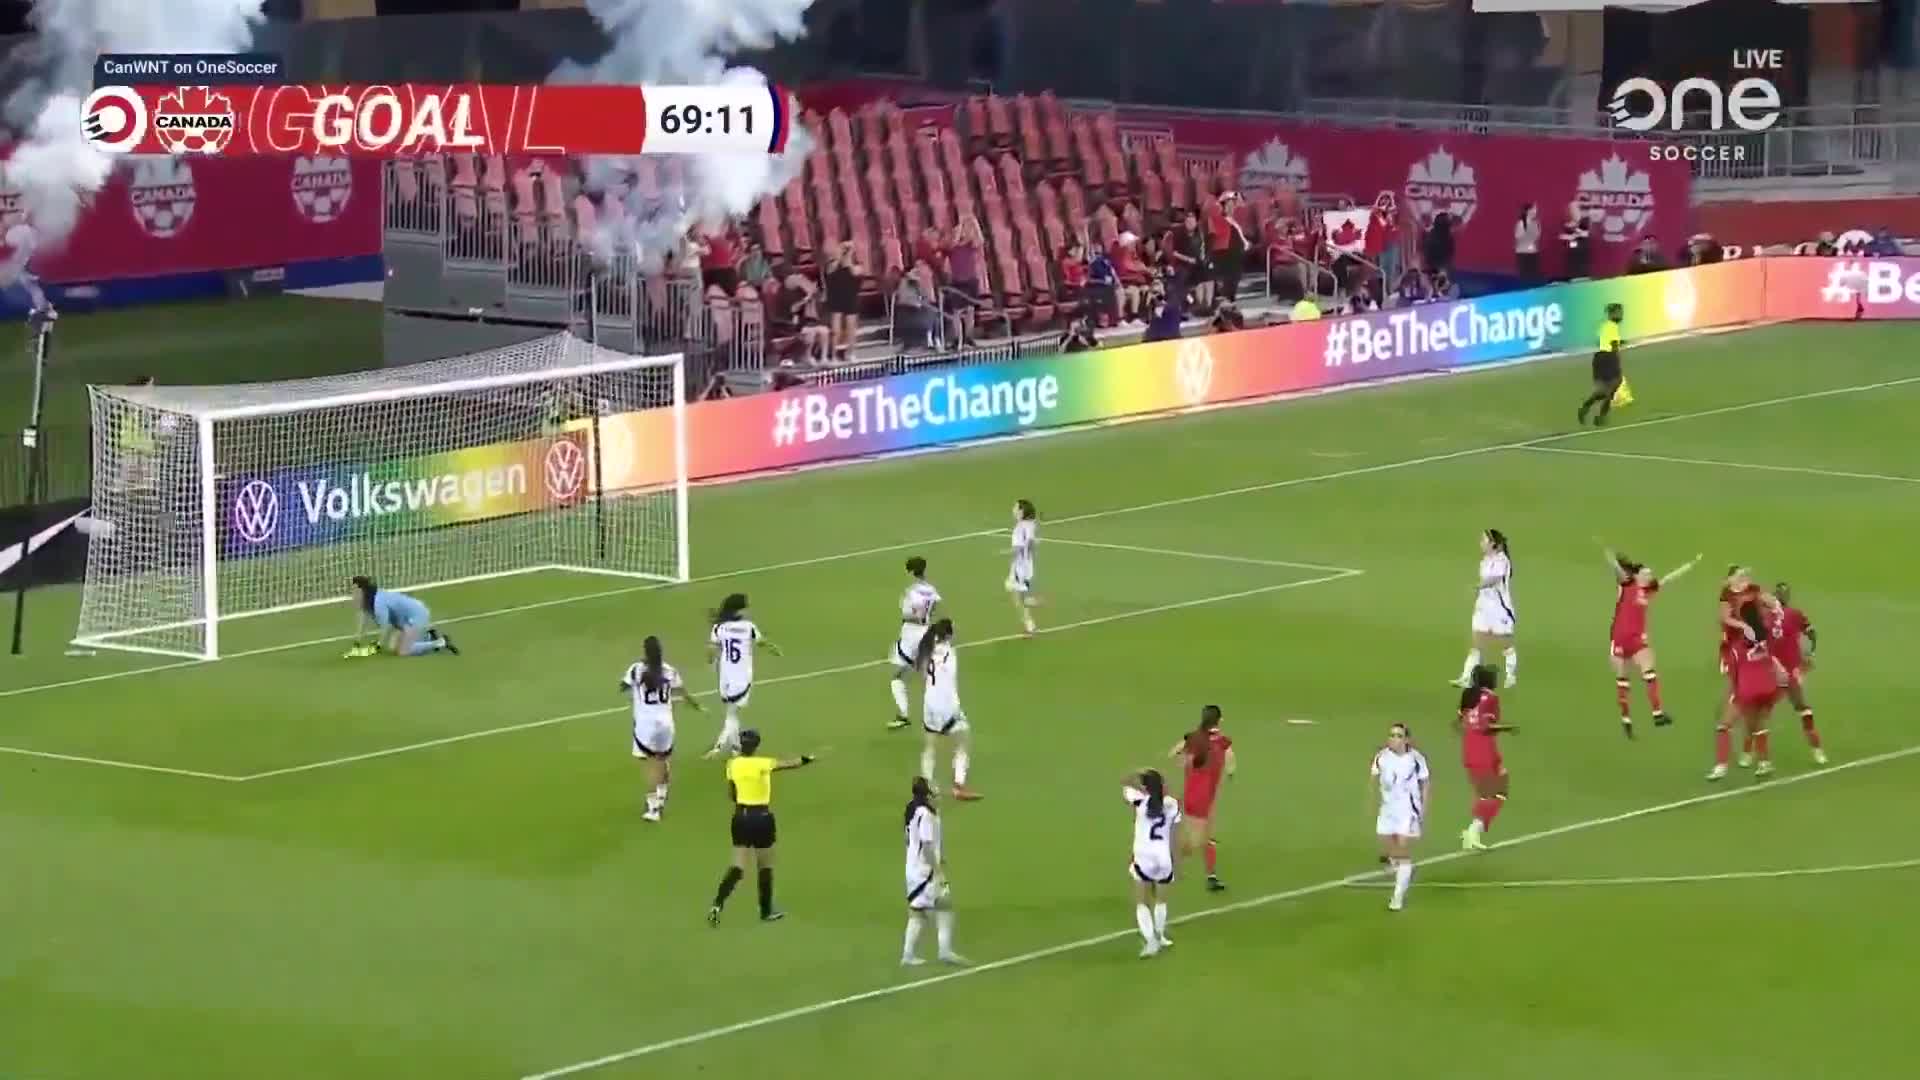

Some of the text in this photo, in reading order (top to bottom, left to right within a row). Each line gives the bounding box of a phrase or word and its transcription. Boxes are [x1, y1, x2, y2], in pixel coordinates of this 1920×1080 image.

[1324, 302, 1563, 368] #BeTheChange
[772, 373, 1060, 448] #BeTheChange
[298, 461, 527, 525] Volkswagen
[725, 638, 741, 664] 16
[1149, 814, 1166, 841] 2
